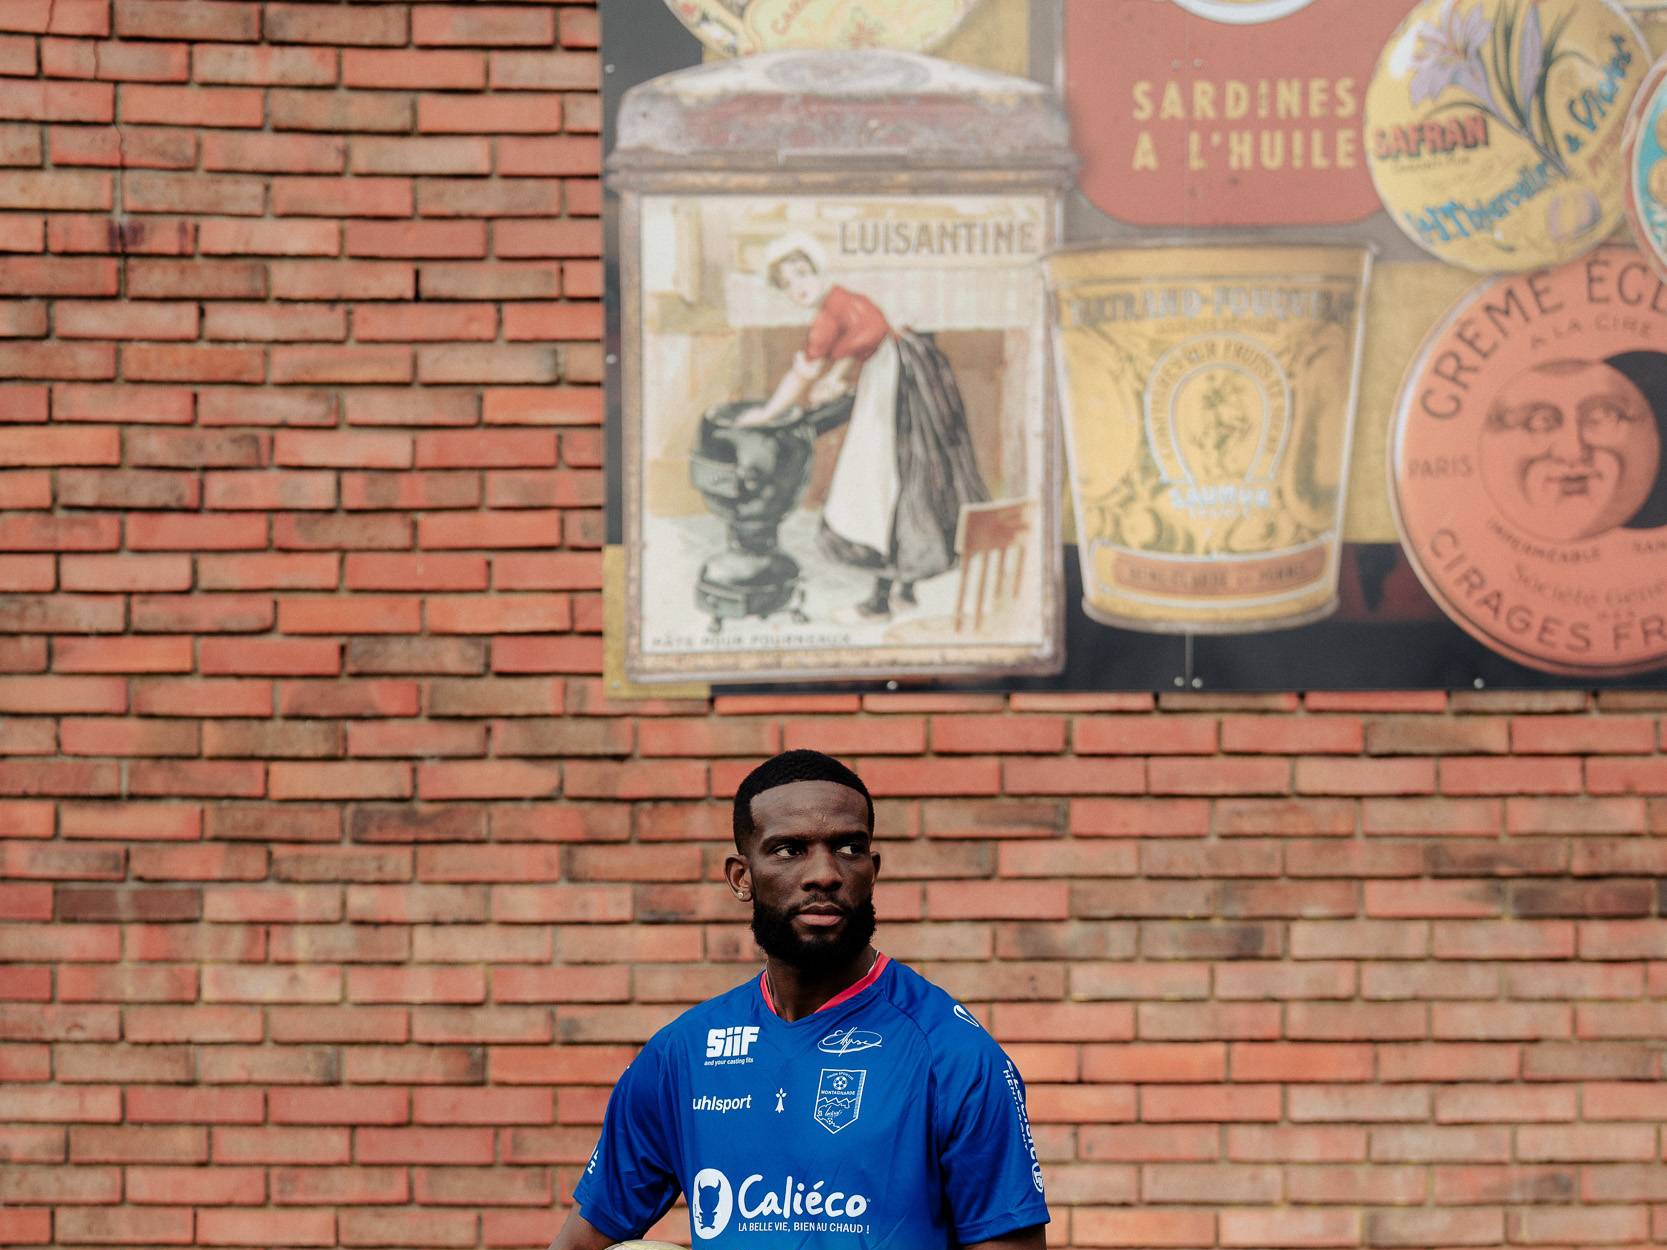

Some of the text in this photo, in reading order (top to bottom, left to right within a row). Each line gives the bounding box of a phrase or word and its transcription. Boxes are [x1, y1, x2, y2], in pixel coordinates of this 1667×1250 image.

[1131, 78, 1357, 121] SARDINES
[1131, 128, 1357, 171] A L'HUILE
[1374, 112, 1490, 161] SAFRAN
[839, 220, 1036, 256] LUISANTINE
[1419, 268, 1564, 421] CREME
[1407, 454, 1473, 479] PARIS
[1430, 527, 1592, 652] CIRAGES
[692, 1094, 752, 1114] uhlsport
[737, 1174, 868, 1219] Caliéco
[738, 1222, 748, 1232] LA
[749, 1221, 773, 1232] BELLE
[774, 1221, 791, 1233] VIE,
[793, 1221, 815, 1232] BIEN
[816, 1222, 827, 1232] AU
[829, 1222, 863, 1233] CHAUD
